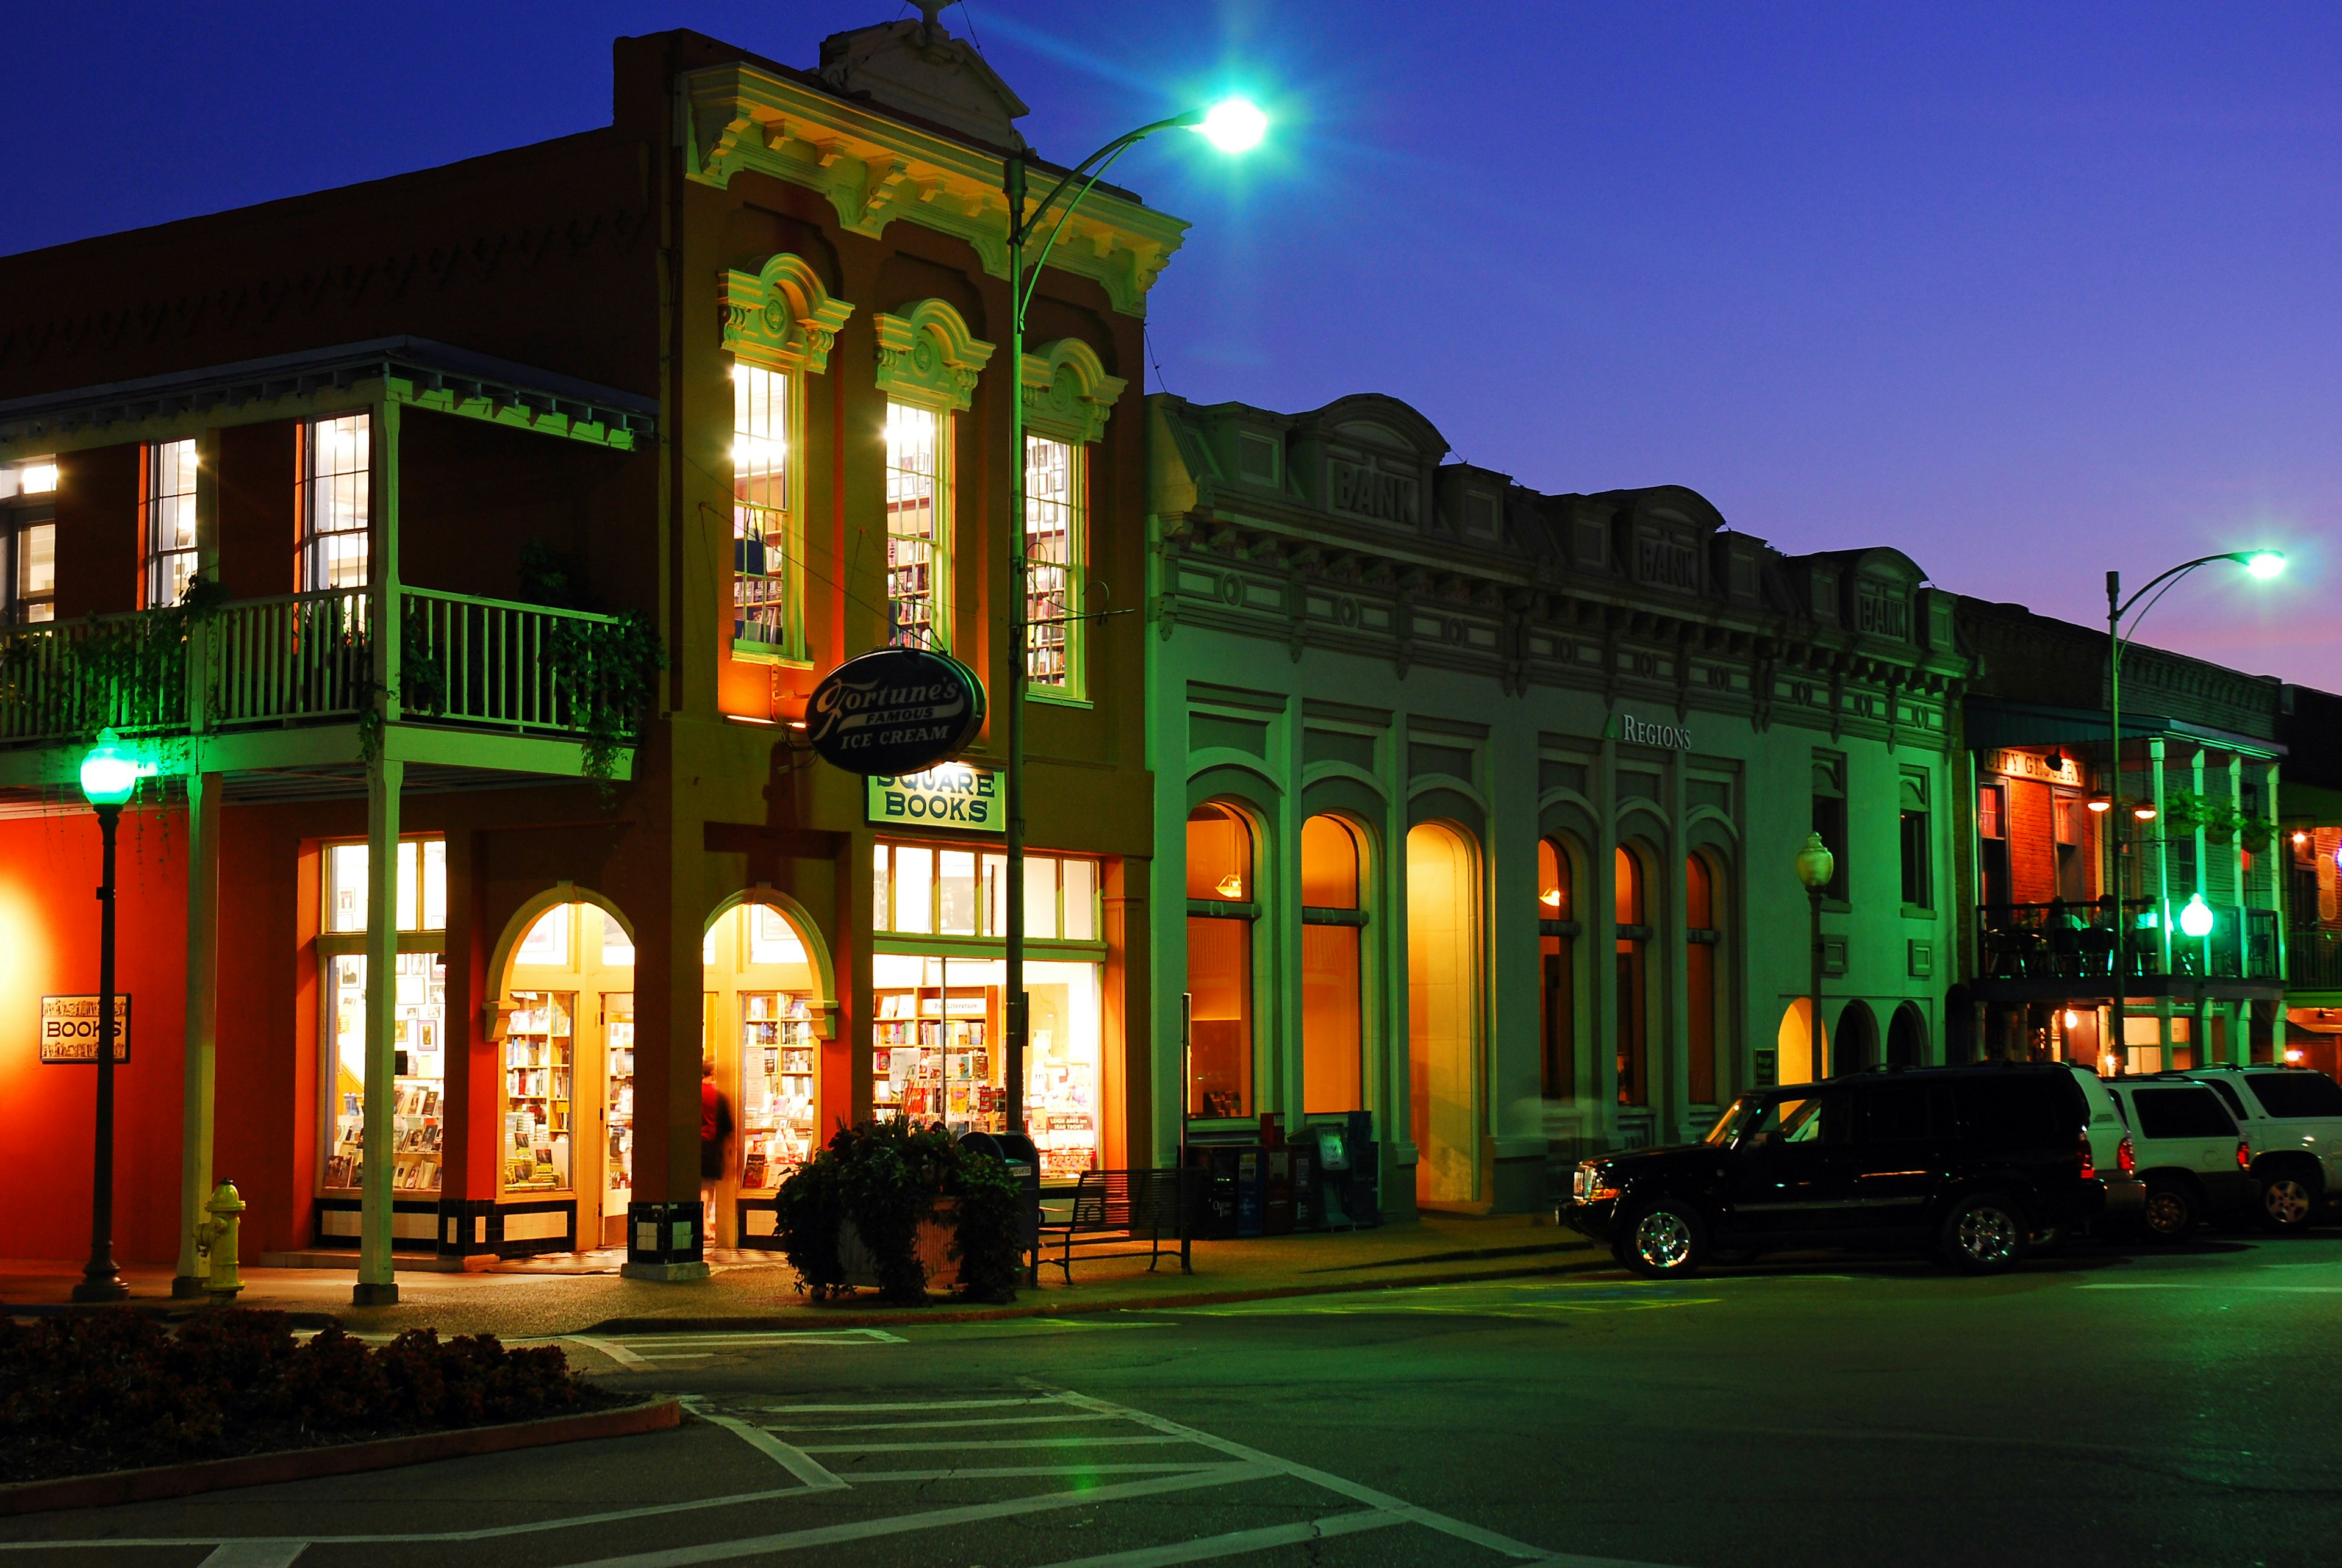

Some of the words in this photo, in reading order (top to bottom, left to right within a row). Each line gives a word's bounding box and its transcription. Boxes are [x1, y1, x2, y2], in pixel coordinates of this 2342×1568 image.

[1334, 462, 1418, 525] BANK
[1639, 540, 1699, 588] BANK
[1860, 594, 1906, 639] BANK
[812, 676, 960, 740] Fortune's
[865, 707, 934, 724] FAMOUS
[840, 732, 873, 750] ICE
[879, 725, 949, 744] CREAM
[1624, 714, 1691, 750] REGIONS
[1986, 750, 2018, 771] CITY
[2025, 756, 2082, 782] GRERY
[885, 791, 987, 823] BOOKS
[47, 1020, 122, 1037] BOOKS
